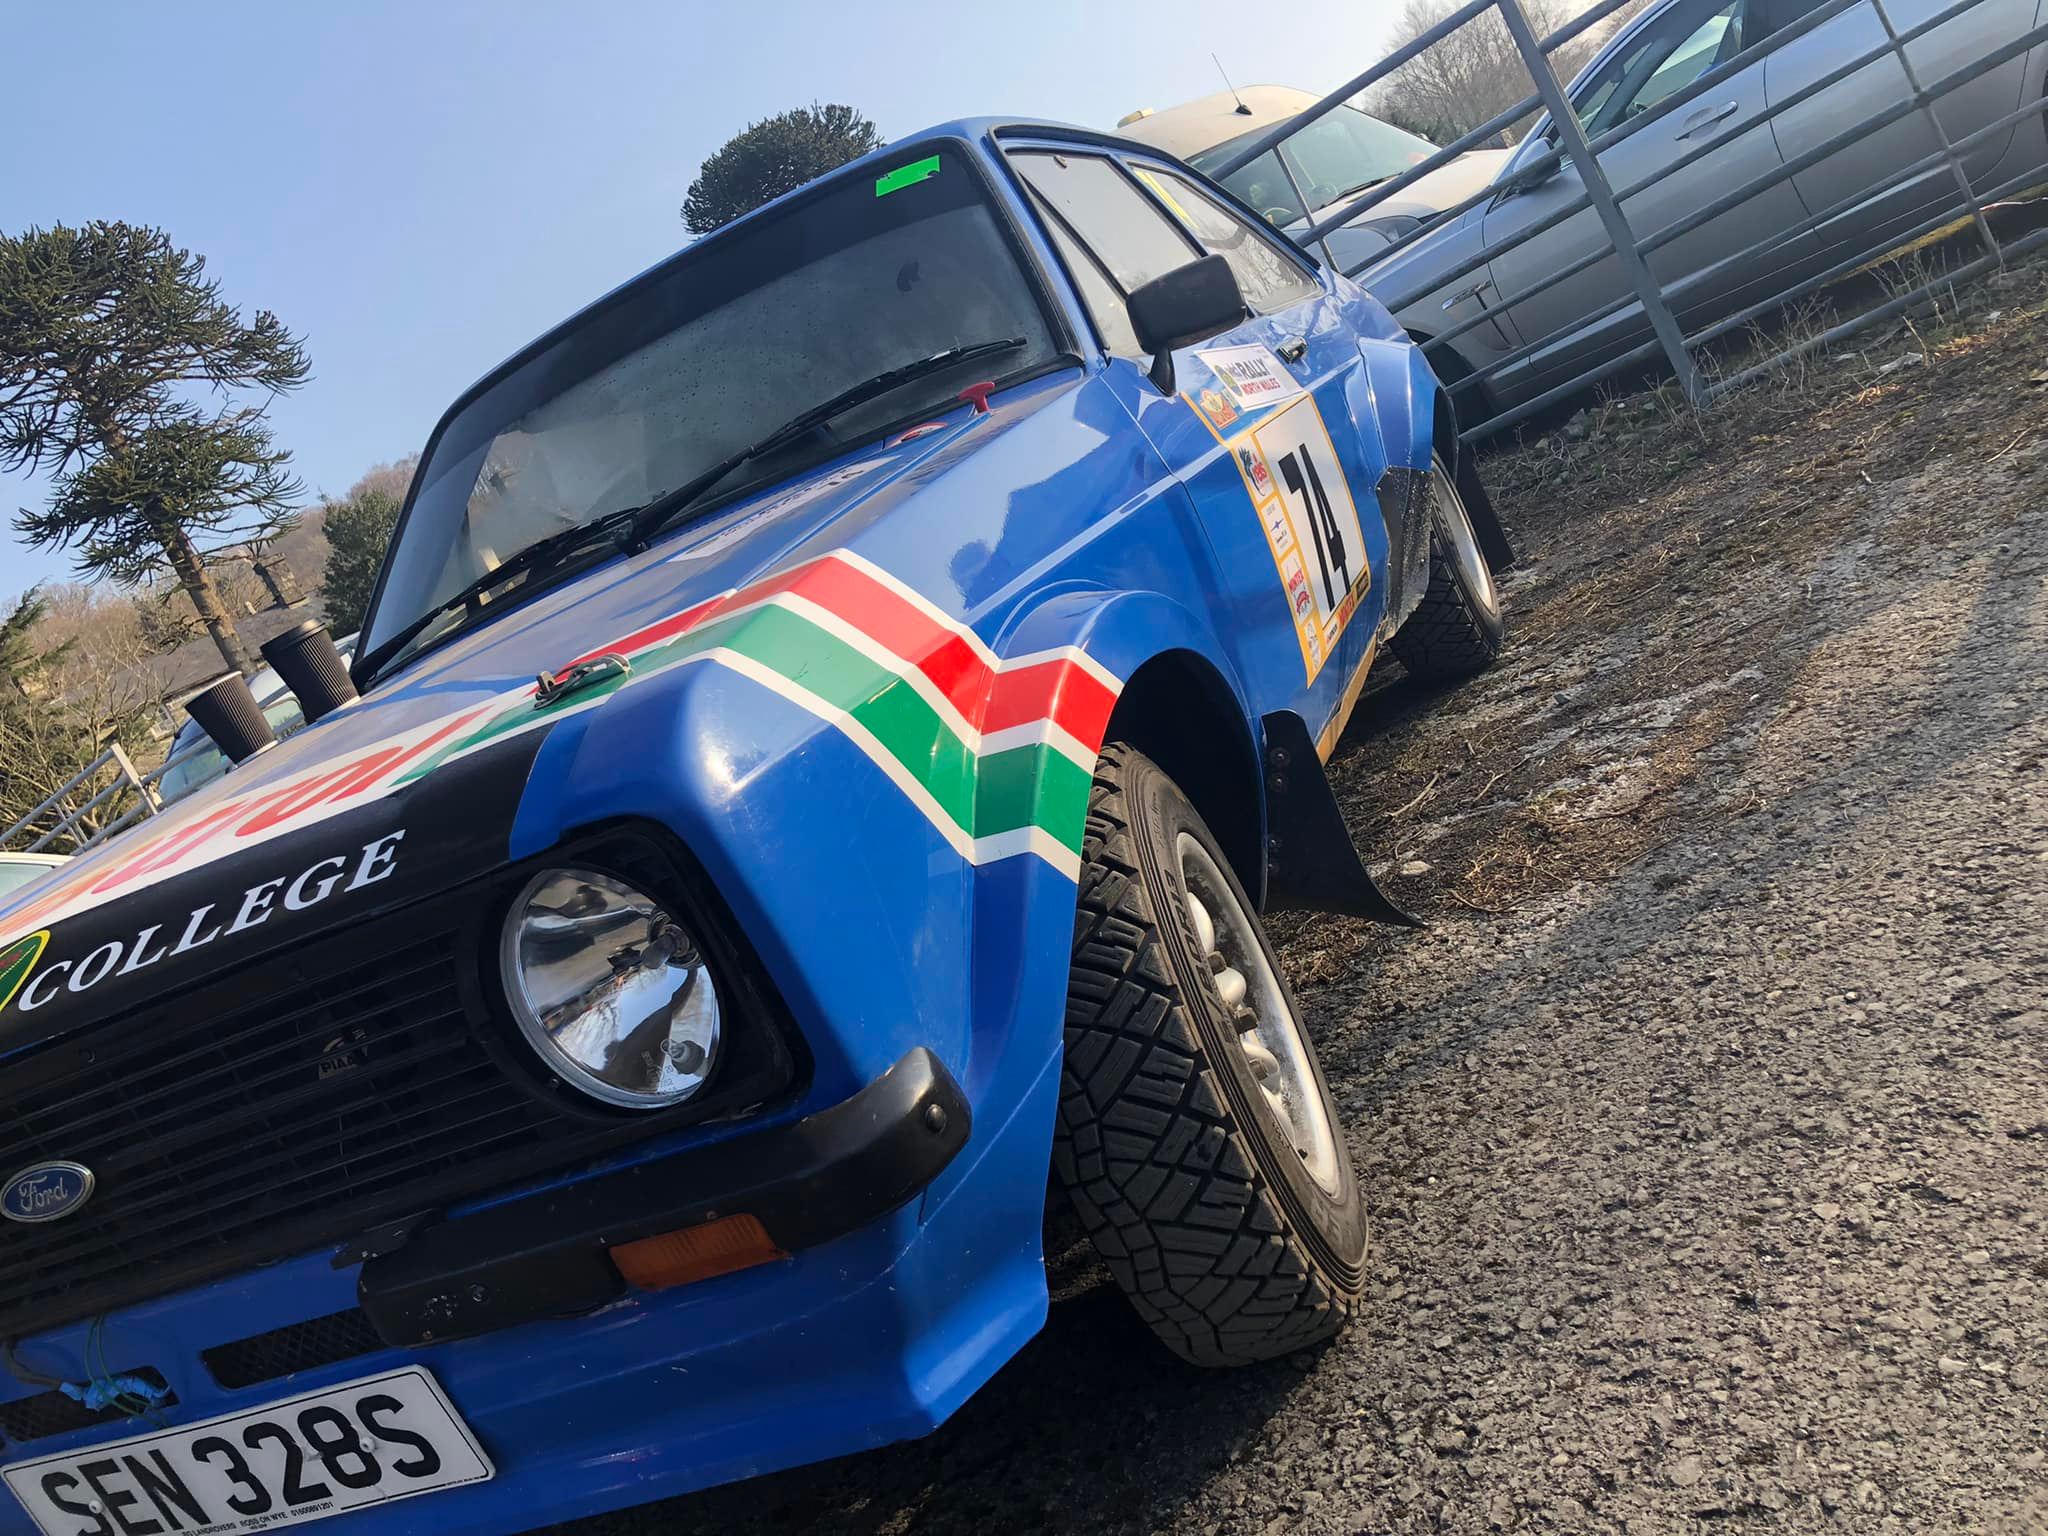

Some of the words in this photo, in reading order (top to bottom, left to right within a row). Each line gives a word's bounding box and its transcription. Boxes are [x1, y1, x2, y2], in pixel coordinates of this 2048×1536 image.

[18, 829, 406, 1011] COLLEGE
[19, 1175, 69, 1212] Ford
[41, 1449, 211, 1536] SEN
[191, 1394, 441, 1517] 328S
